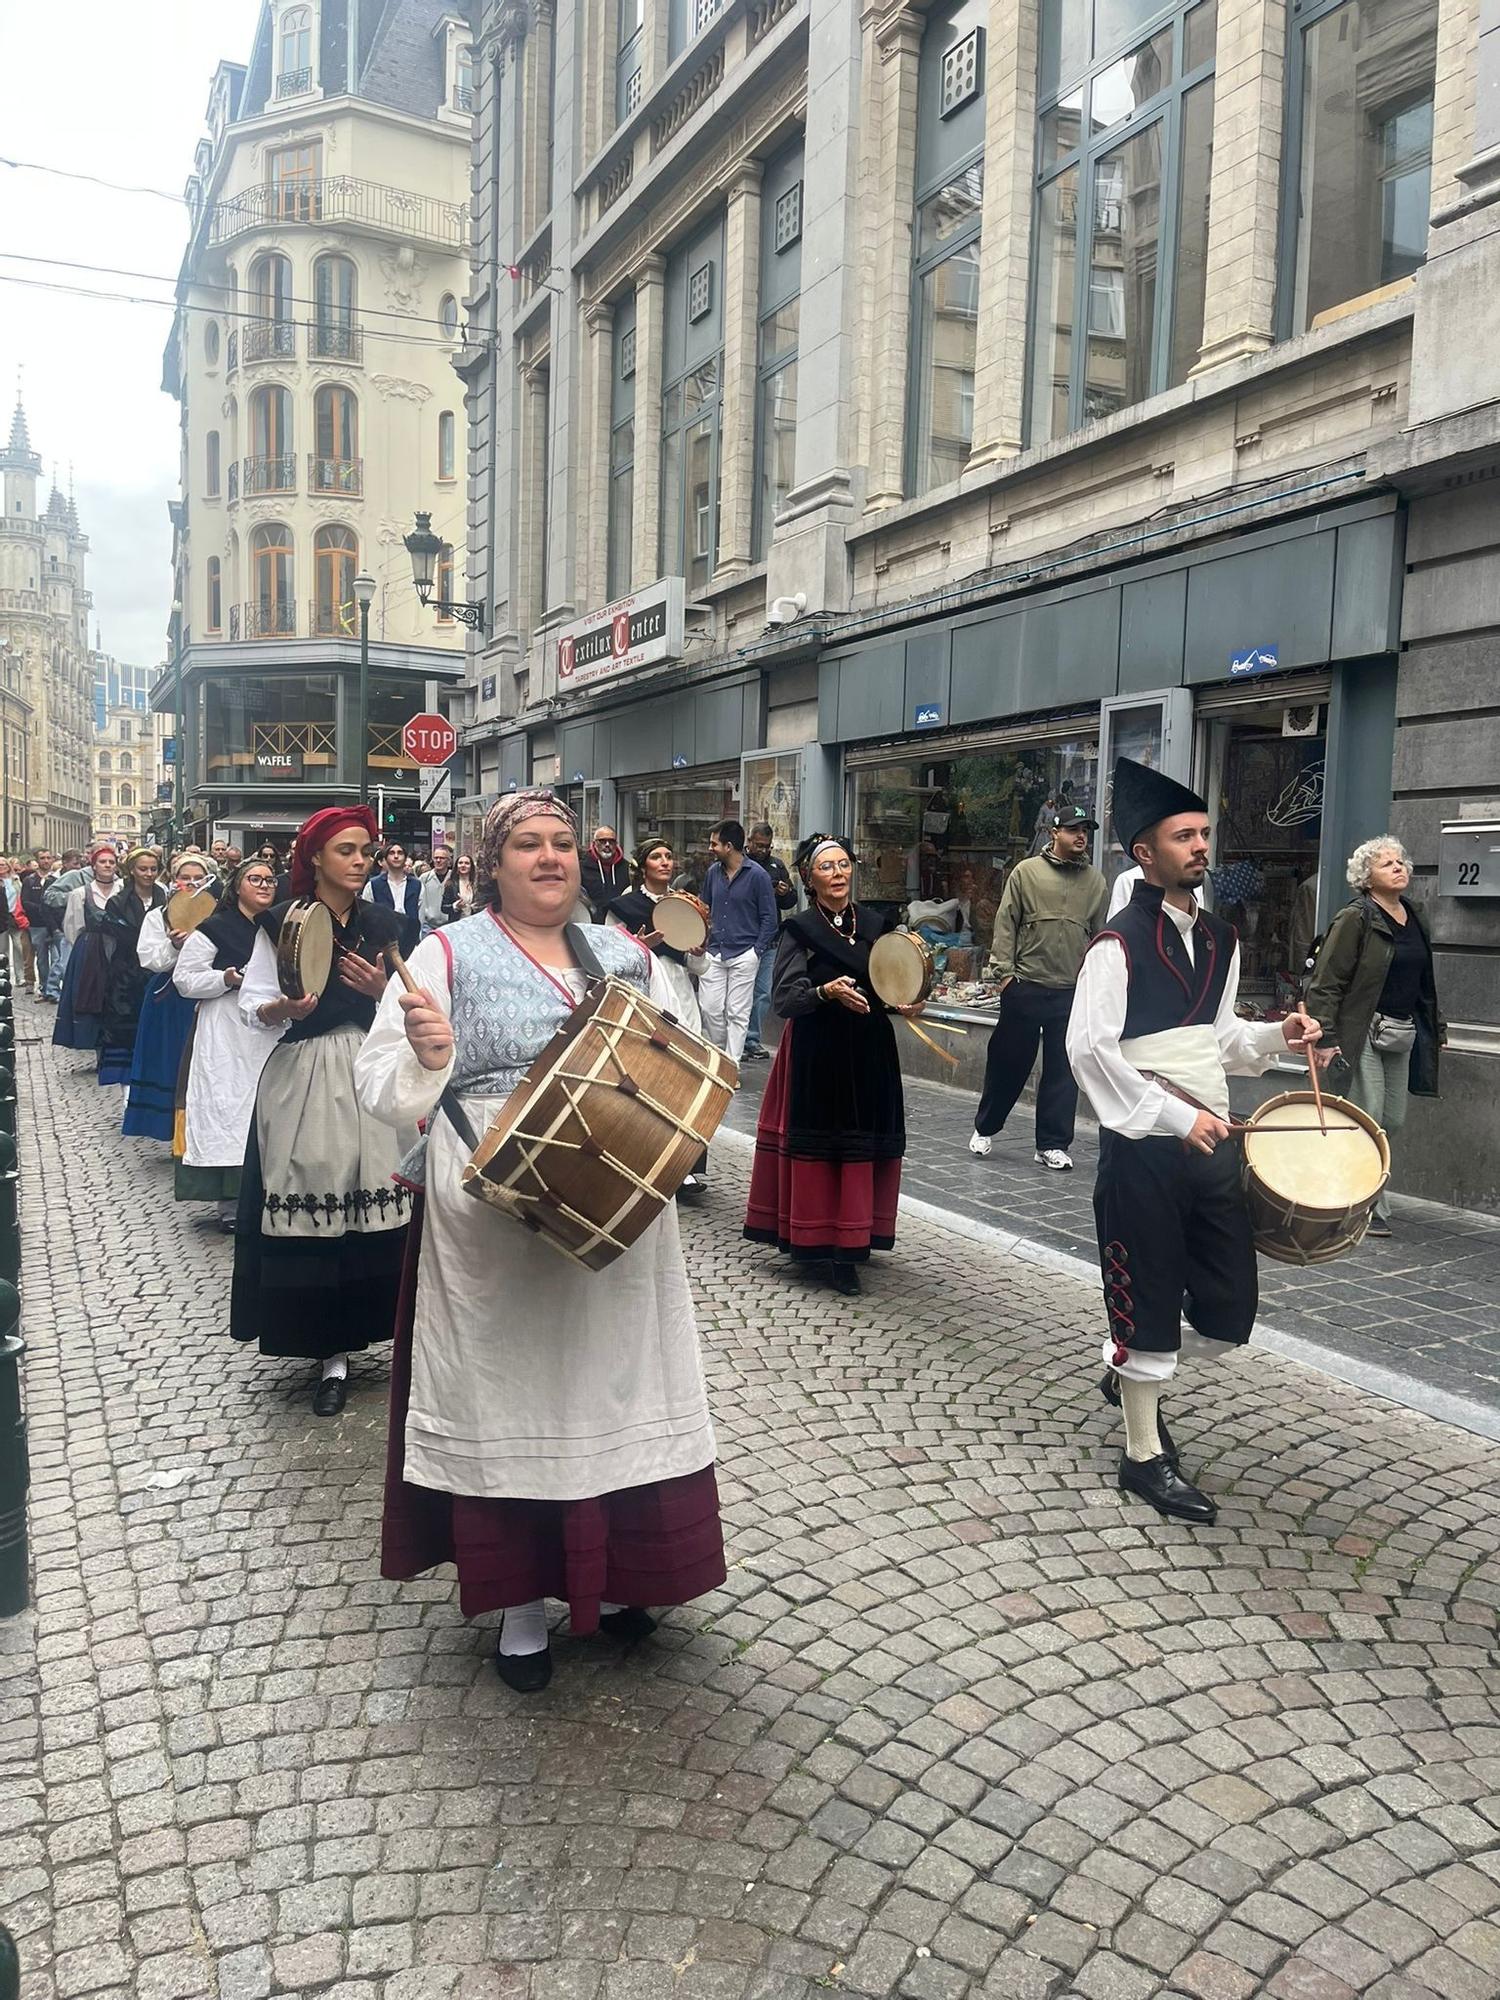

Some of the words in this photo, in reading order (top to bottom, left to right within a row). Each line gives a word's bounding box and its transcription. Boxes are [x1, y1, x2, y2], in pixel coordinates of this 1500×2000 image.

[596, 609, 608, 621] OUR
[599, 665, 611, 676] AND
[611, 660, 622, 671] ART
[623, 653, 645, 667] TEXTILE
[406, 729, 453, 750] STOP
[257, 755, 292, 767] WAFFLE
[1458, 862, 1480, 886] 22
